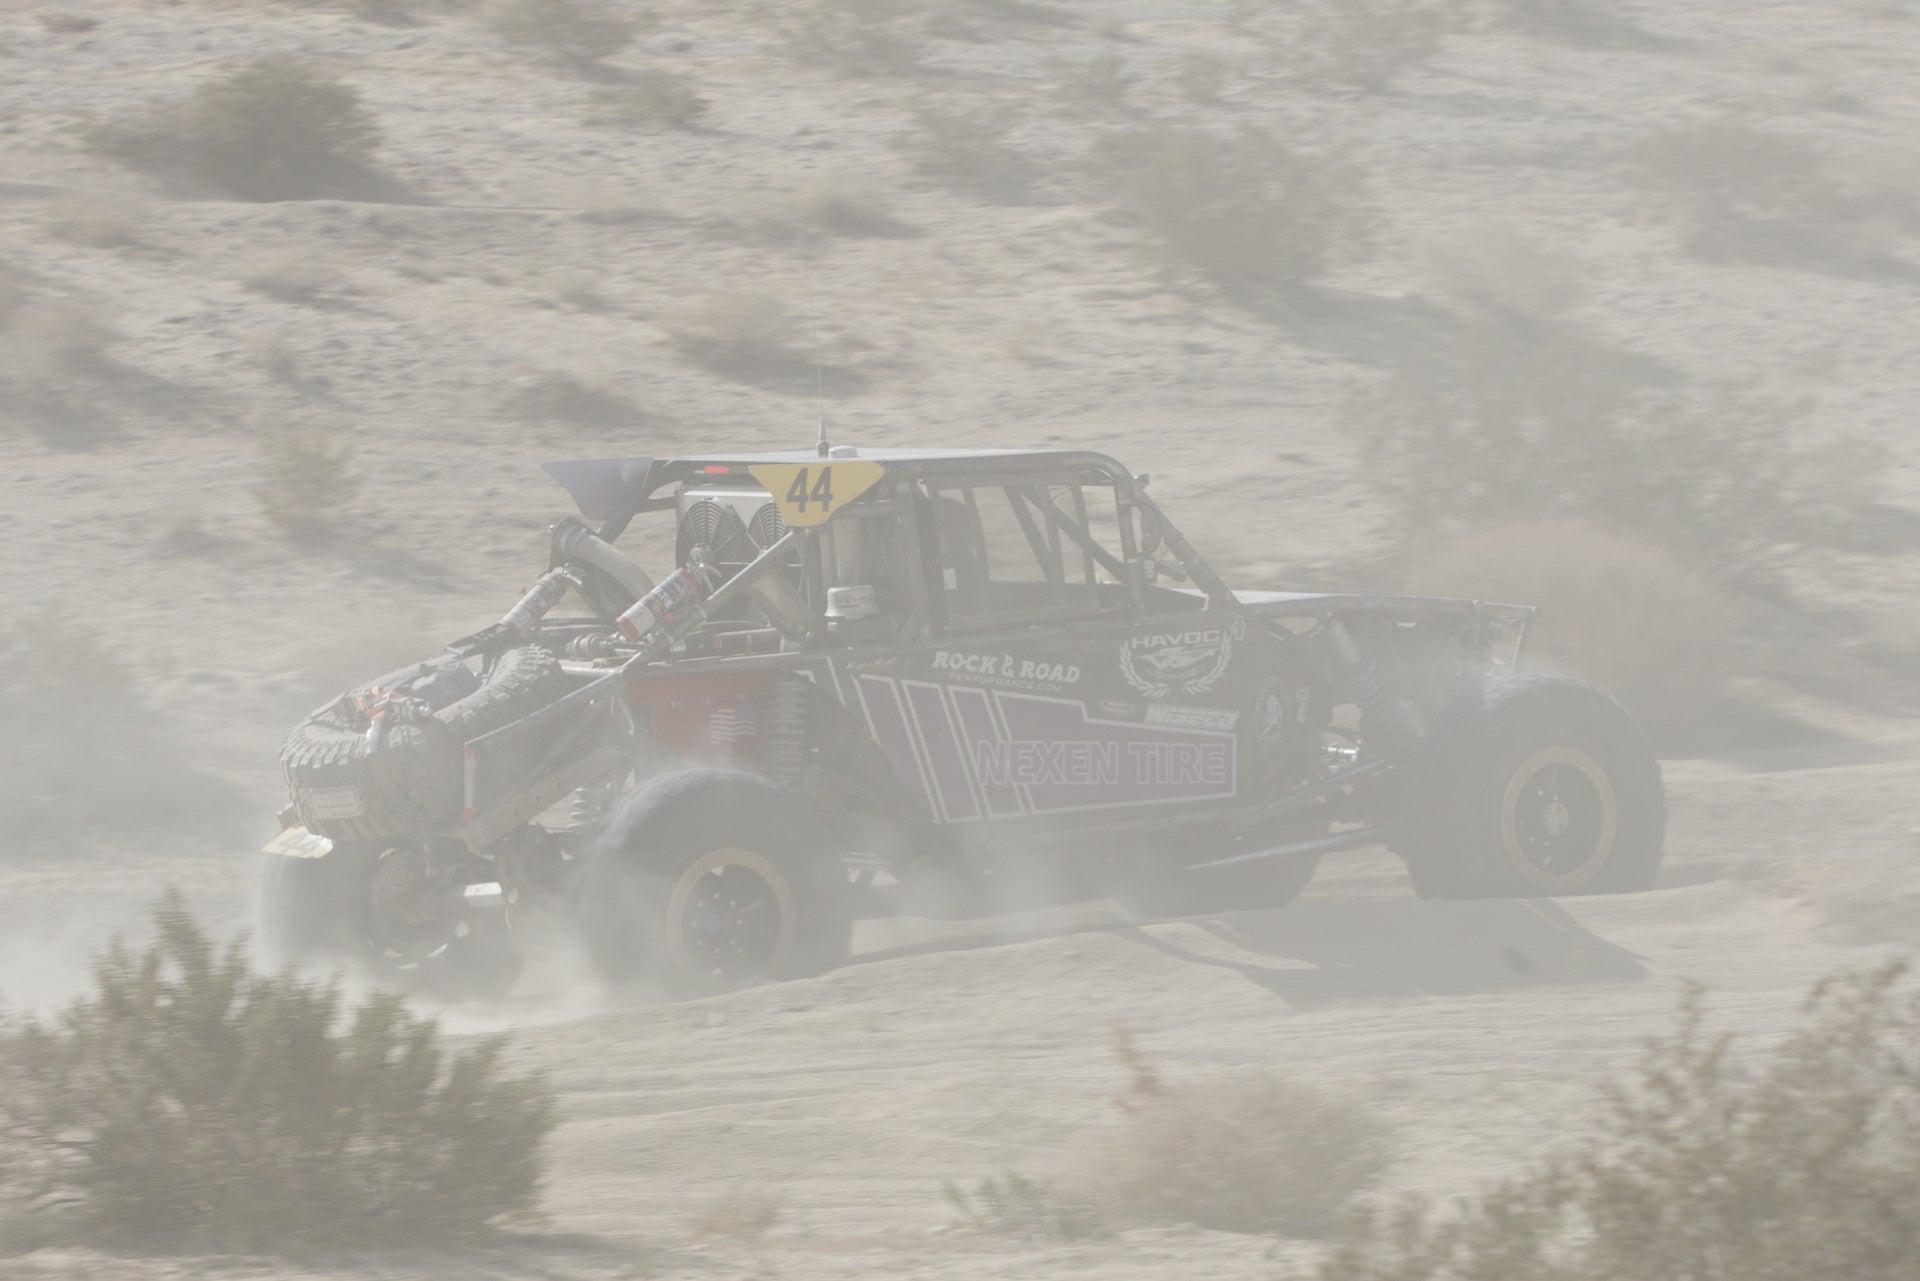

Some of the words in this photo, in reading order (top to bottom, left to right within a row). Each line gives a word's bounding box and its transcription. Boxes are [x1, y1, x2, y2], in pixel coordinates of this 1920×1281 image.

[786, 466, 833, 513] 44
[1131, 629, 1220, 649] HAVOC
[932, 650, 998, 675] ROCK
[1018, 660, 1080, 683] ROAD
[977, 739, 1119, 785] NEXEN
[1128, 741, 1226, 785] TIRE
